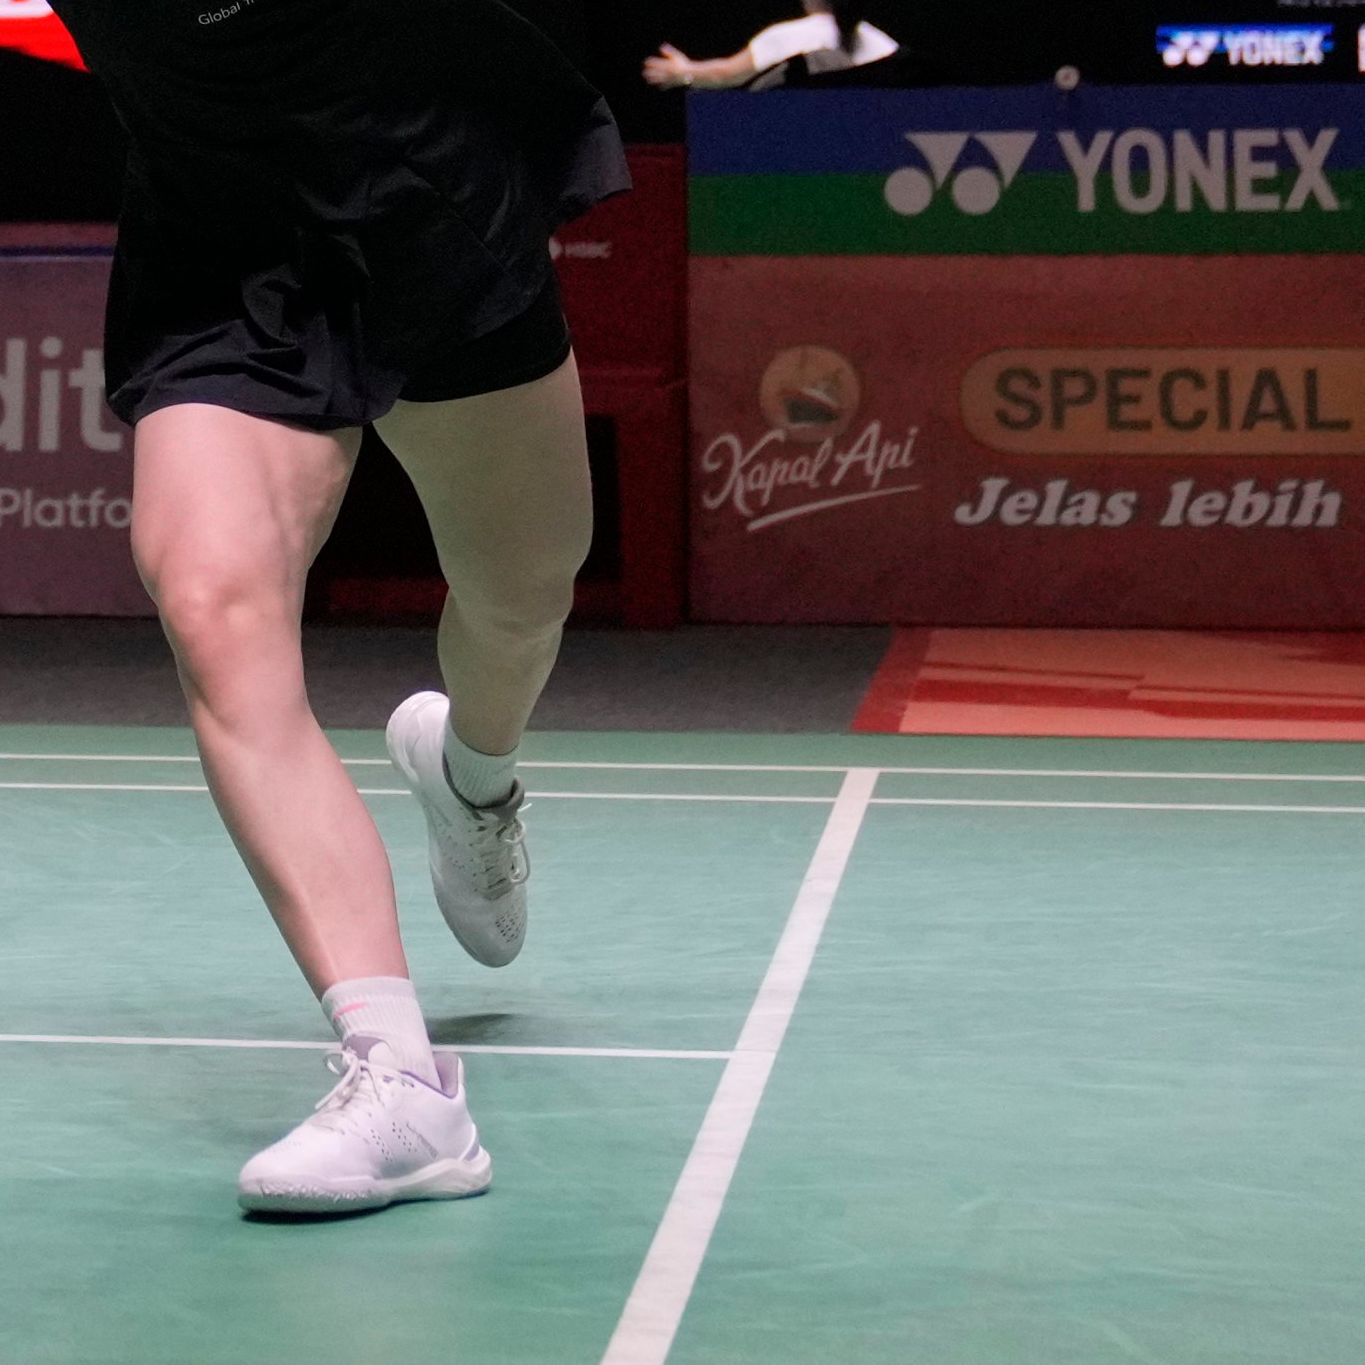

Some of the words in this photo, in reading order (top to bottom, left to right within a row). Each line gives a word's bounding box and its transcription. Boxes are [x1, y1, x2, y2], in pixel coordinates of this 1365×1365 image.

[197, 1, 242, 26] Global
[1223, 29, 1326, 66] YONEX
[1056, 128, 1340, 213] YONEX
[994, 366, 1351, 433] SPECIAL
[702, 428, 834, 517] Kapal
[830, 419, 919, 488] Api
[954, 476, 1140, 528] Jelas
[1159, 477, 1343, 528] lebih
